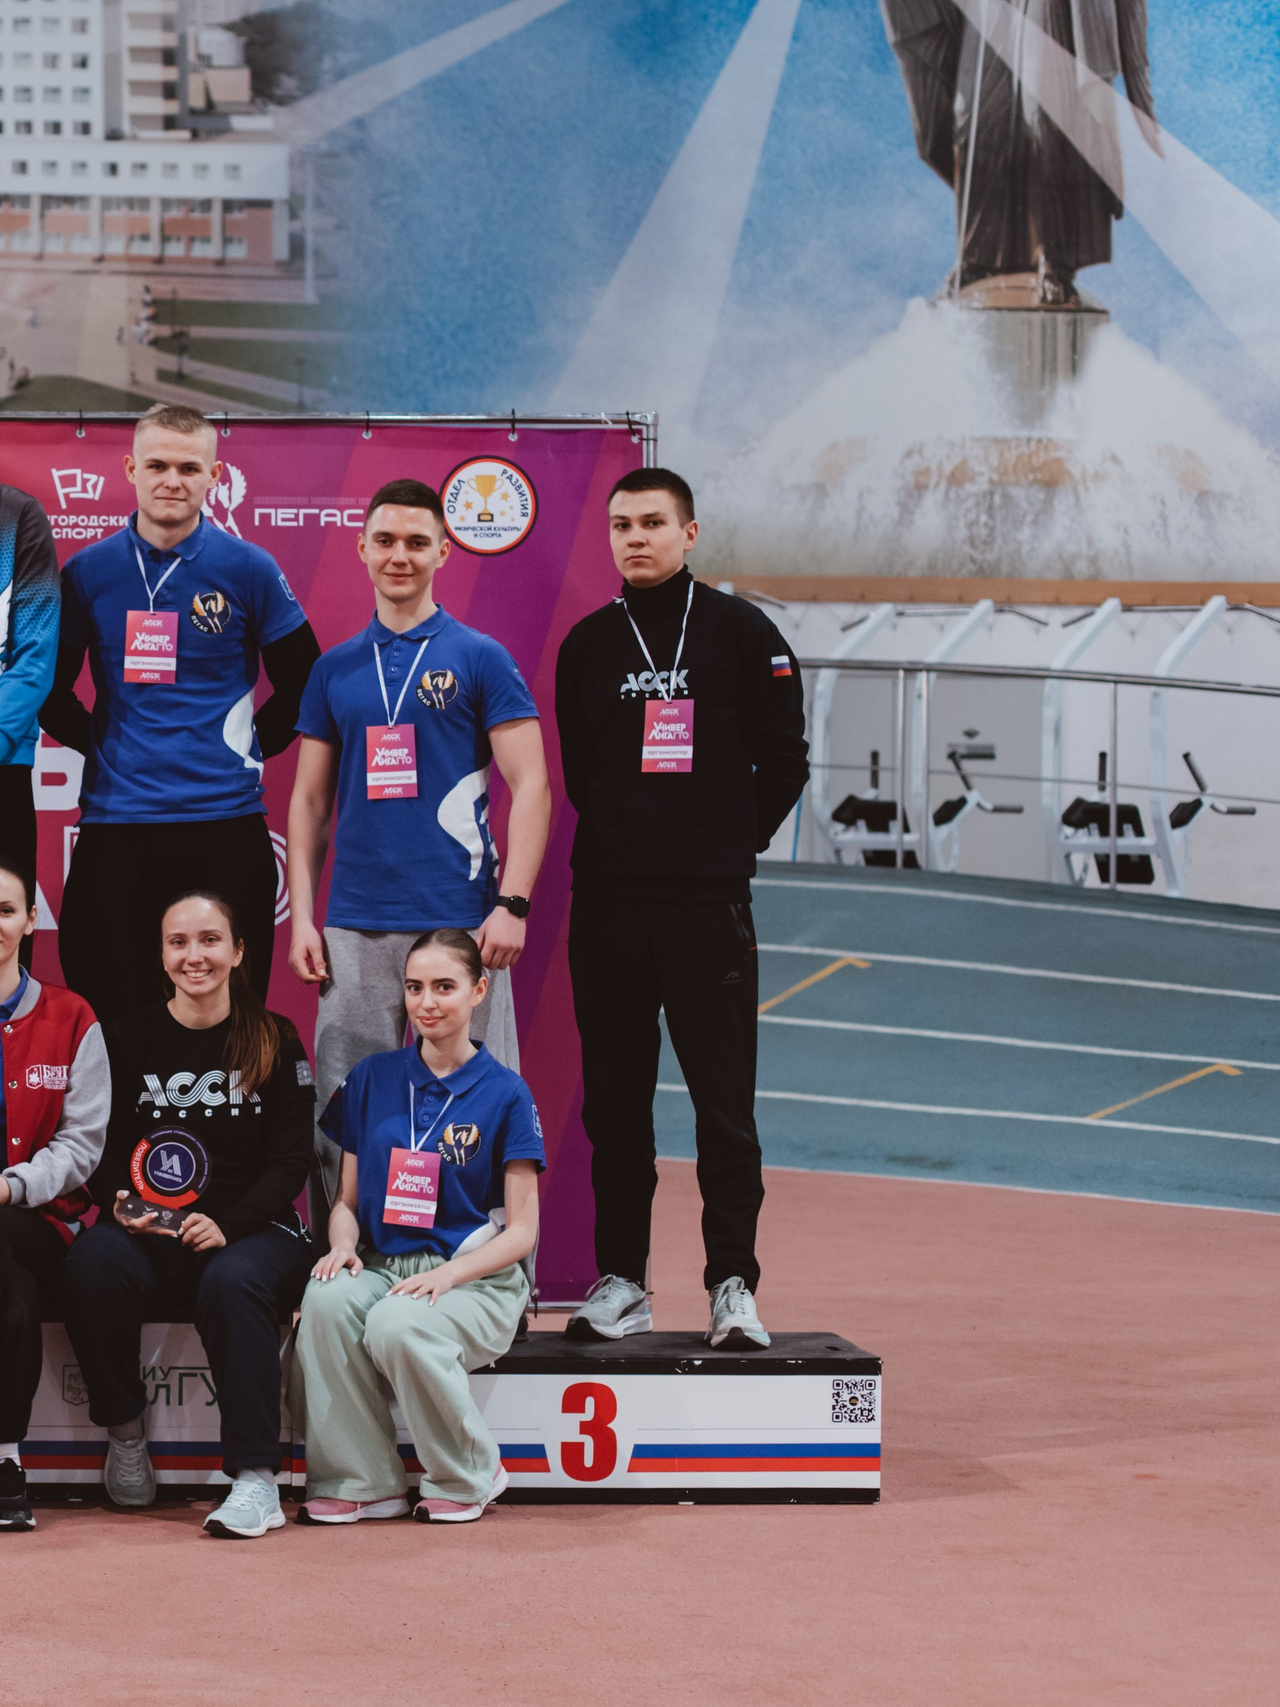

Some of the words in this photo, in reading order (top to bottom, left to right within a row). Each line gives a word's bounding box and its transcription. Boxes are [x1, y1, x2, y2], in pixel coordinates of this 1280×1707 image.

[447, 479, 466, 514] ОТДЕЛ
[501, 468, 529, 517] РАЗВИТИЯ
[48, 515, 128, 526] ГОРОДСКИ
[254, 508, 364, 527] ПЕГАС
[52, 528, 104, 539] СПОРТ
[191, 615, 208, 632] ПЕГАС
[620, 669, 689, 693] АССК
[138, 1070, 261, 1107] АССК
[136, 1106, 261, 1118] ОССИИ
[438, 1143, 451, 1161] ПЕГАС
[132, 1142, 147, 1190] ПОБЕДИТЕЛЬ
[561, 1382, 617, 1481] 3
